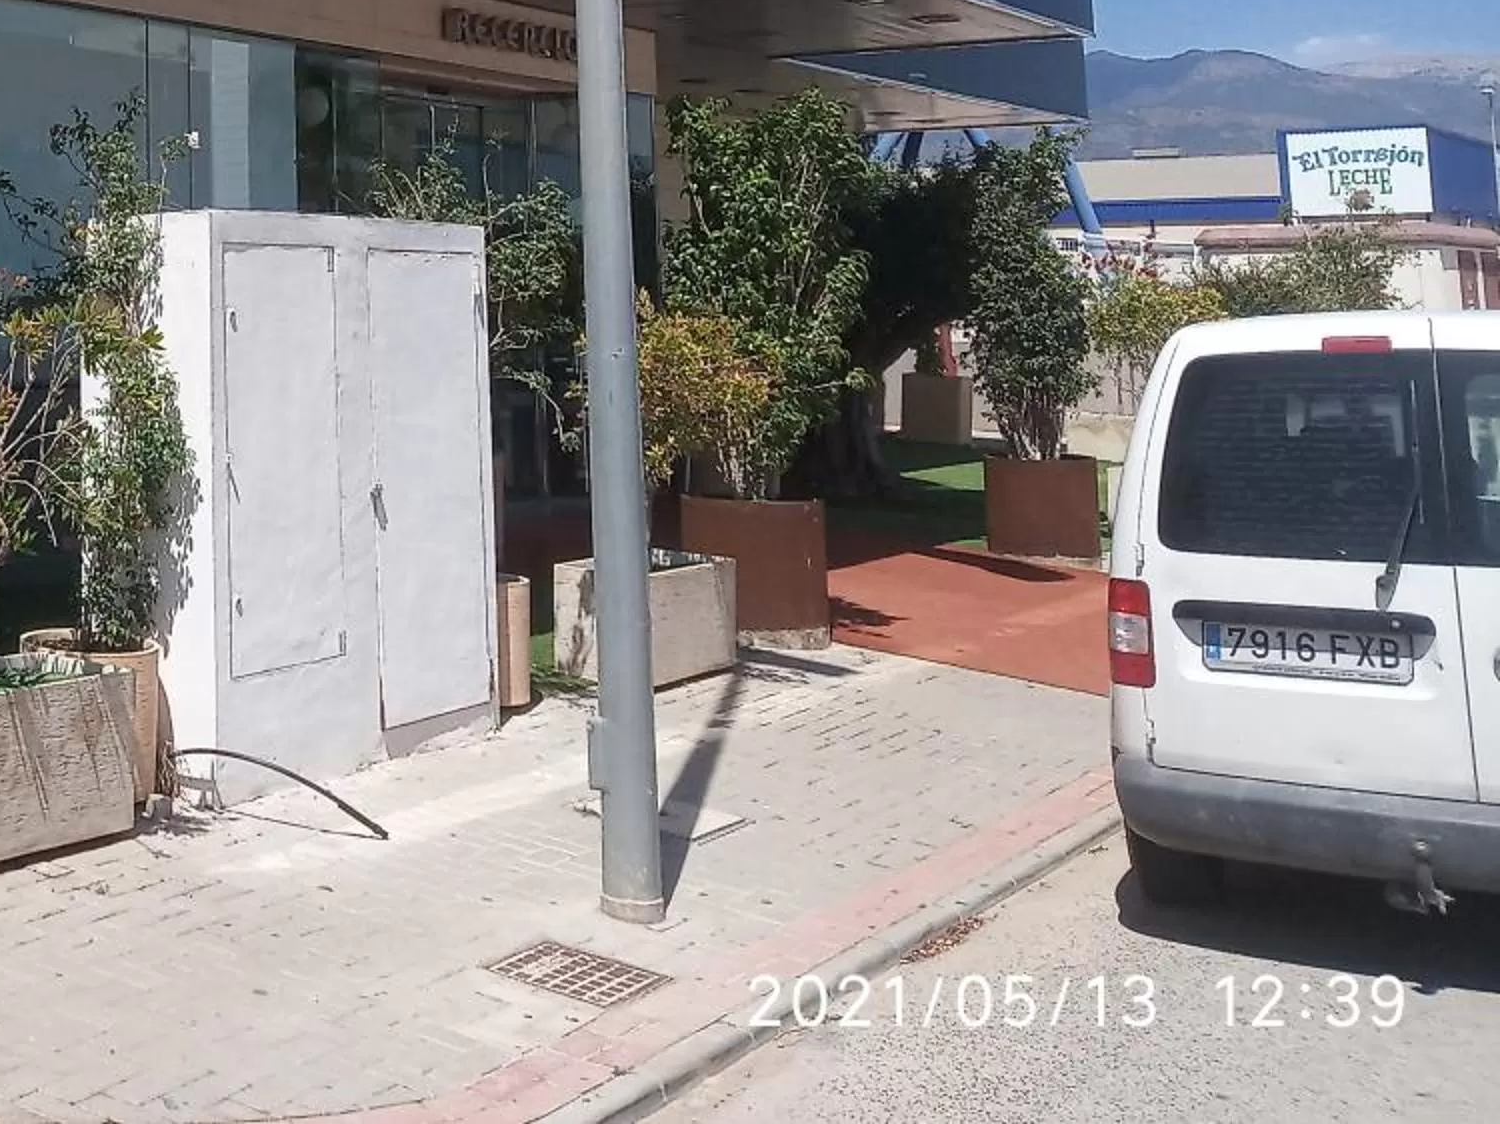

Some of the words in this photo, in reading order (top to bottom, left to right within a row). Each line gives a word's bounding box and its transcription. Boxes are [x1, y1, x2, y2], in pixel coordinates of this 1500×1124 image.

[1292, 151, 1323, 172] El
[1321, 143, 1424, 167] Torrejón
[1327, 168, 1393, 196] LECHE
[1227, 627, 1316, 662] 7916
[1329, 633, 1400, 669] FXB
